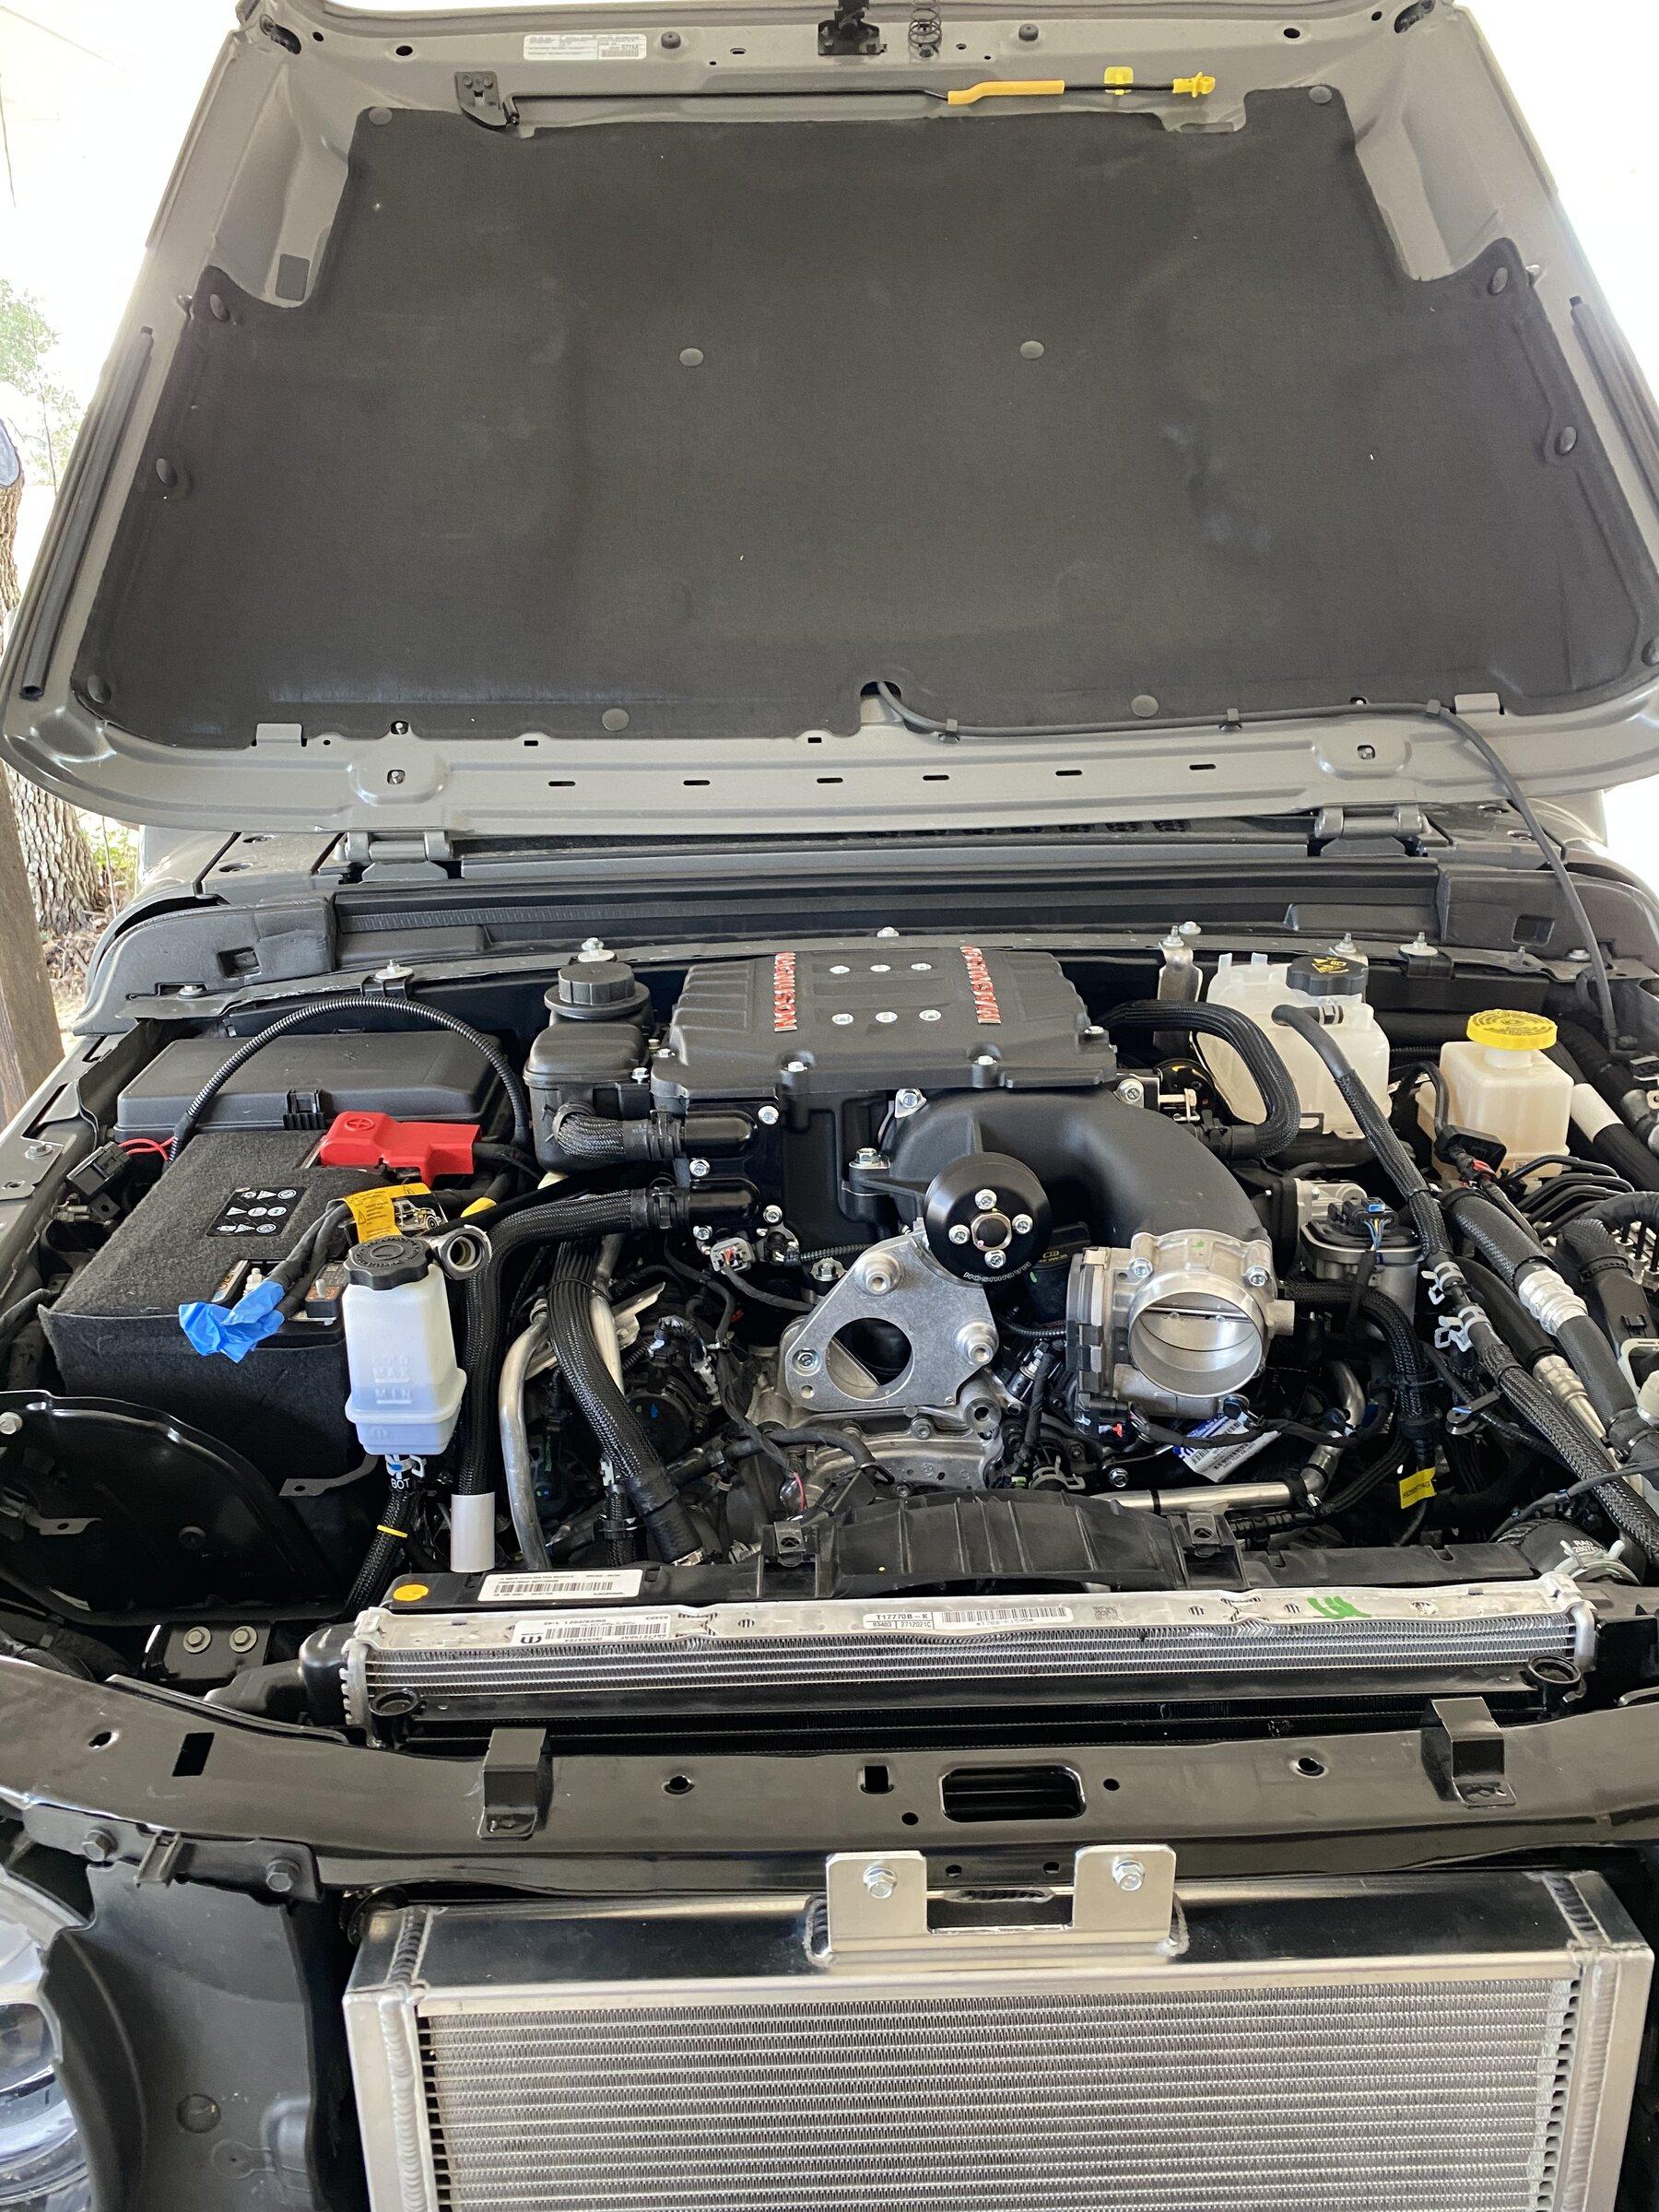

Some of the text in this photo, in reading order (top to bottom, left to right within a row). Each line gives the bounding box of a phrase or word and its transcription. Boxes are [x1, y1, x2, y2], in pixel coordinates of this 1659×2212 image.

[774, 953, 798, 1032] MAGNUSON
[960, 947, 1001, 1024] MAGNUSON
[375, 1389, 411, 1399] MIN
[391, 1477, 410, 1489] BOT
